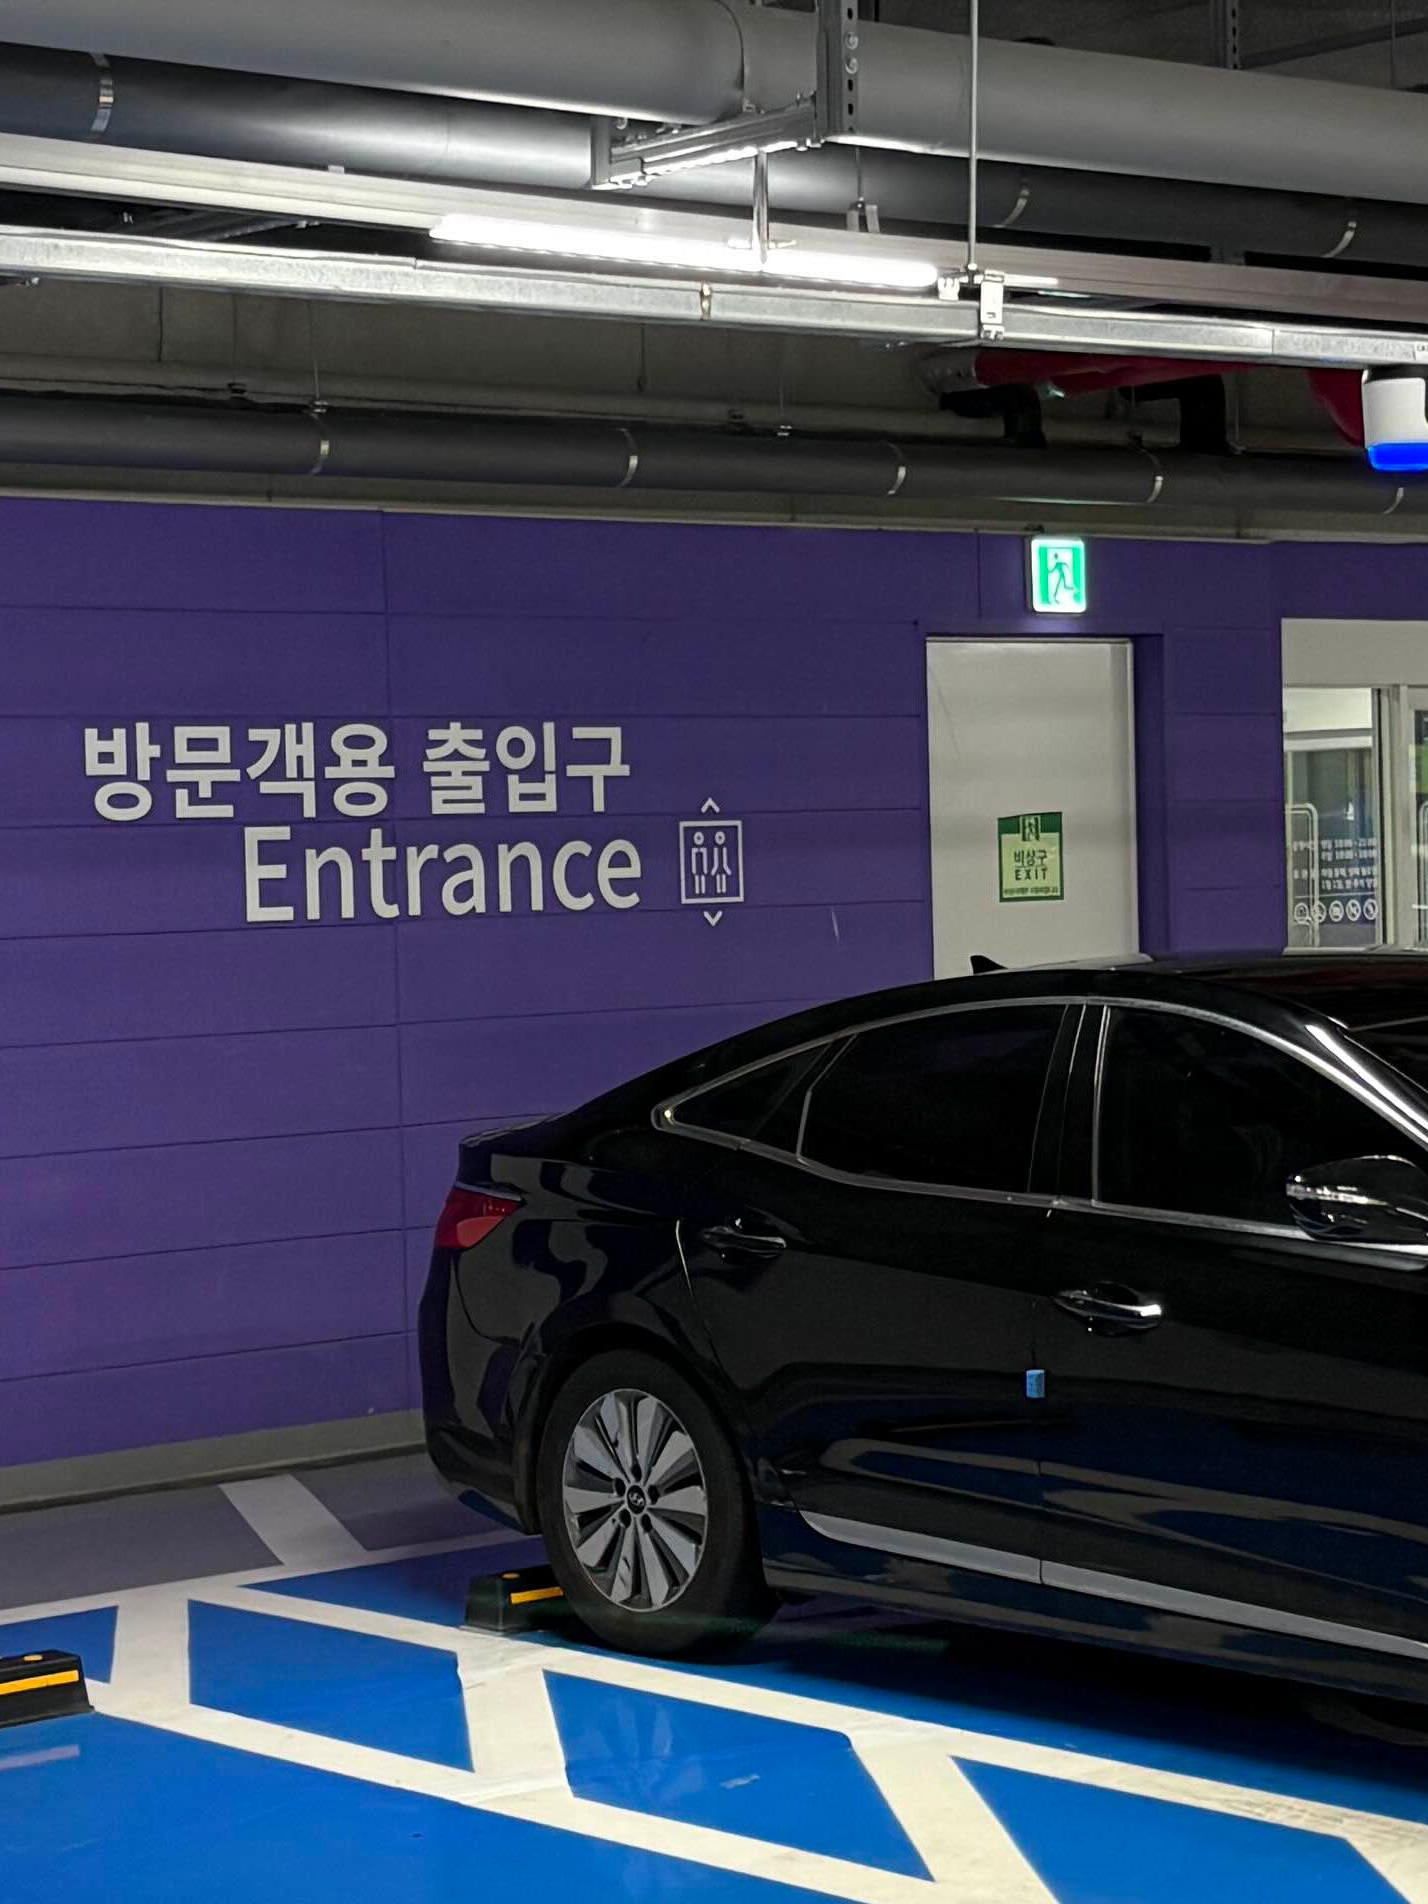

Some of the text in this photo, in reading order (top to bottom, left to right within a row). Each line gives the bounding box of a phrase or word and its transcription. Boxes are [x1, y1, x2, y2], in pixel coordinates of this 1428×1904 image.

[83, 721, 631, 821] 방문객용 출입구
[244, 825, 642, 923] Entrance
[1014, 849, 1047, 867] 비상구
[1015, 867, 1047, 880] EXIT
